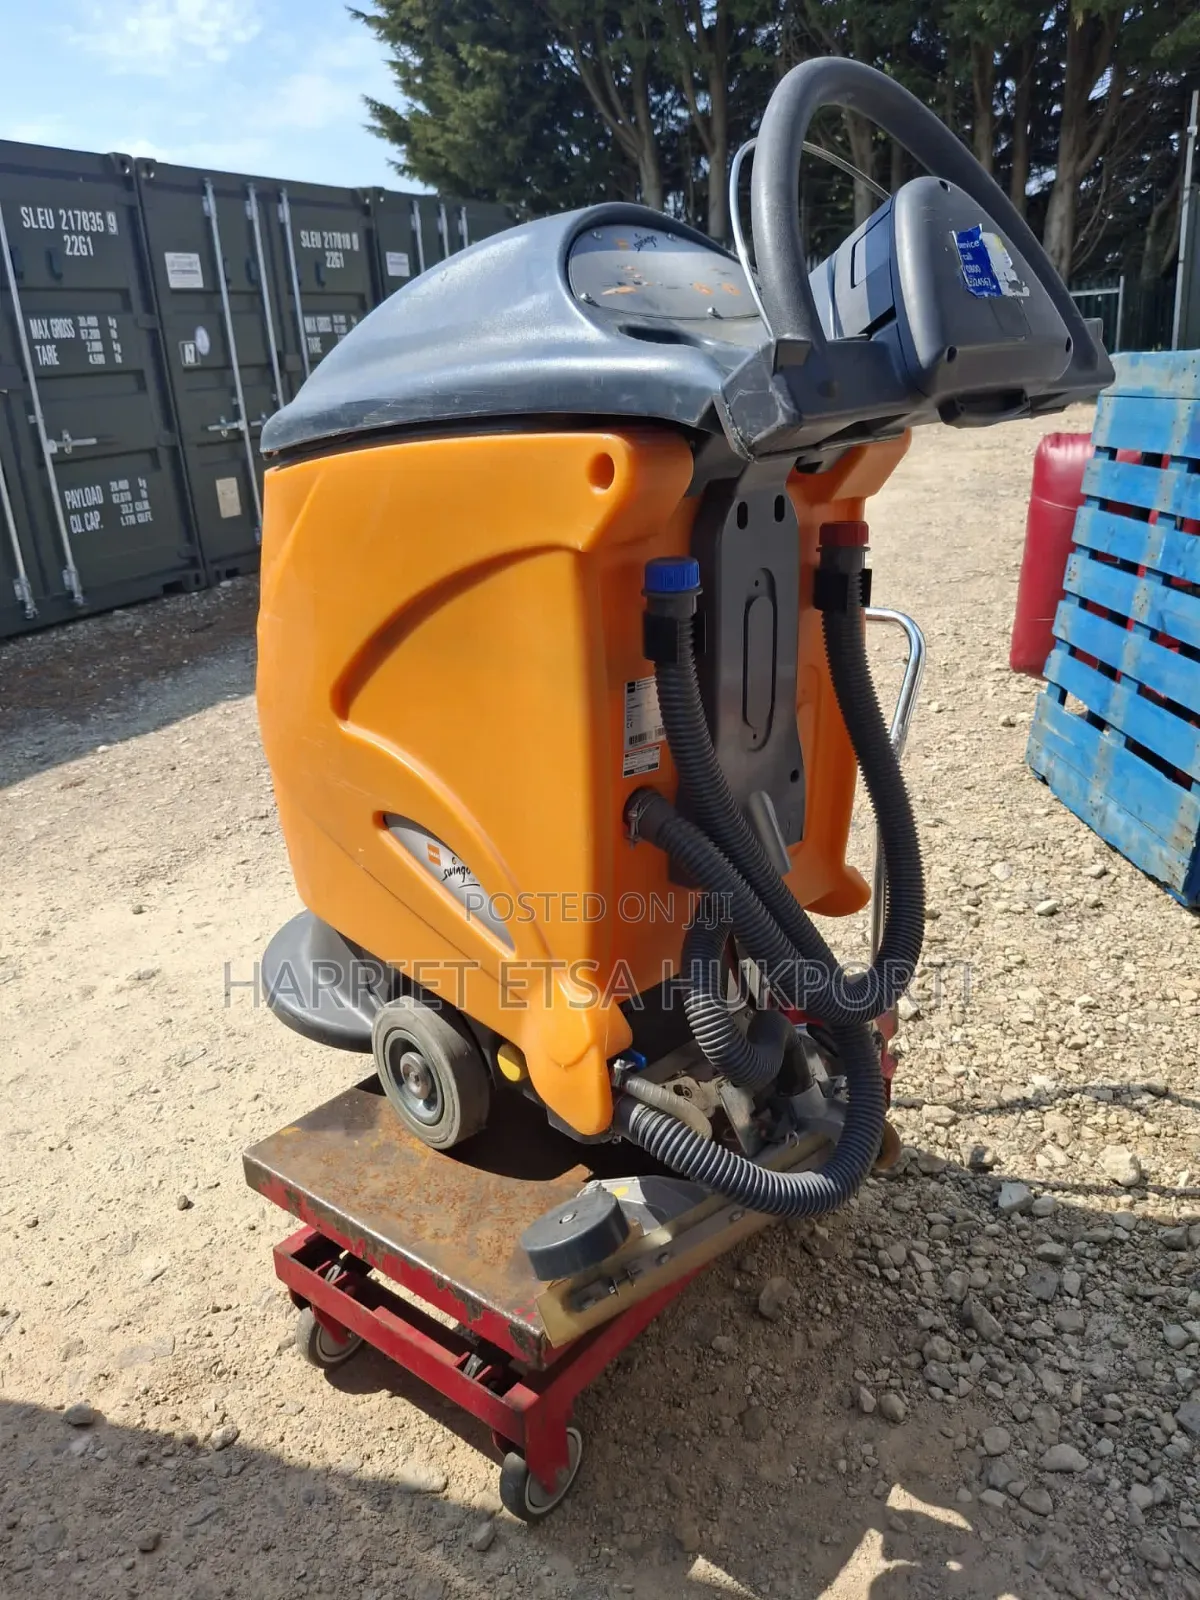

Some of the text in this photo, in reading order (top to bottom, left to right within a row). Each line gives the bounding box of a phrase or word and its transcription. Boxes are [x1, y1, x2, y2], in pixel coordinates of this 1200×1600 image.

[20, 206, 118, 235] SLEU 217835 9
[63, 234, 94, 257] 22G1
[29, 318, 52, 340] MAX
[49, 317, 76, 339] GROSS
[34, 344, 60, 366] TARE
[64, 485, 104, 510] PAYLOAD
[83, 510, 104, 532] CAP.
[441, 865, 472, 884] swingo
